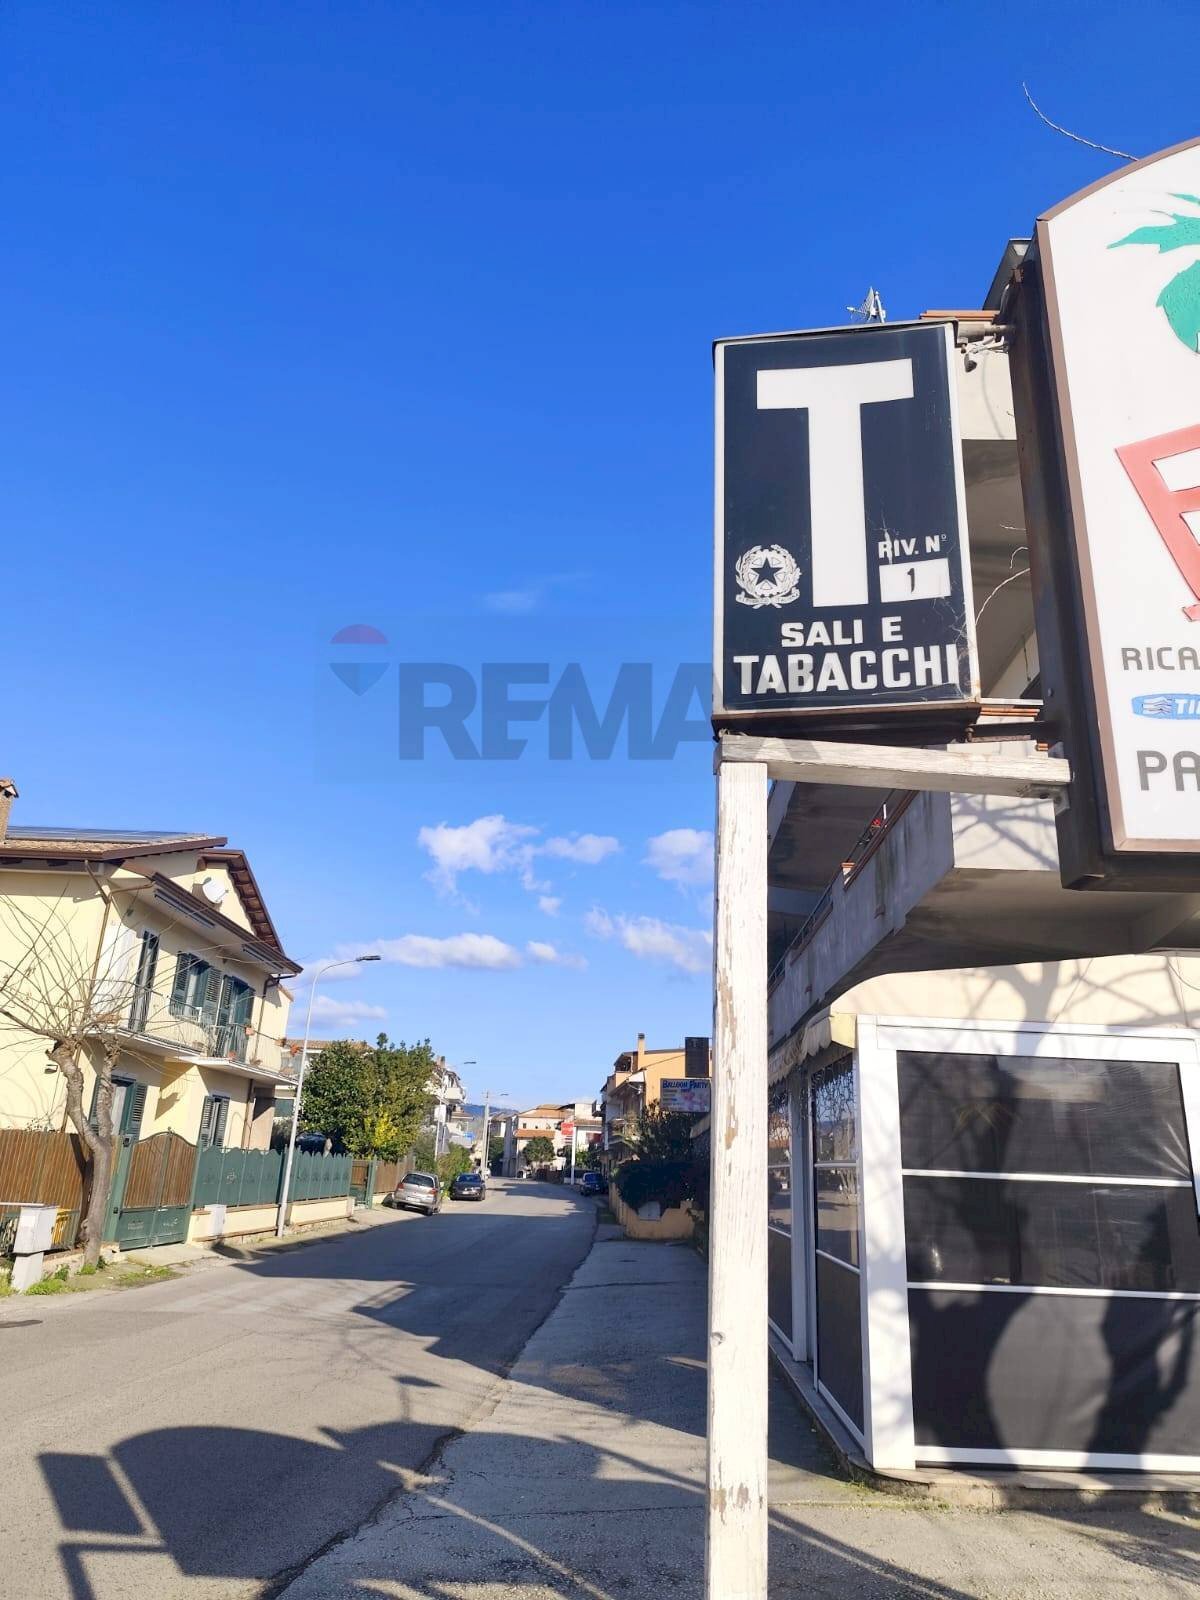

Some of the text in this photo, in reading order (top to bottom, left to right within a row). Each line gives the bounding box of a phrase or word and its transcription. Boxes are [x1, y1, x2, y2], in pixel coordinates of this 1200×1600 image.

[757, 358, 914, 607] T
[878, 537, 919, 558] RIV.
[907, 567, 915, 593] 1
[781, 616, 904, 648] SALI E
[733, 644, 960, 695] TABACCHI
[1175, 698, 1200, 715] TI
